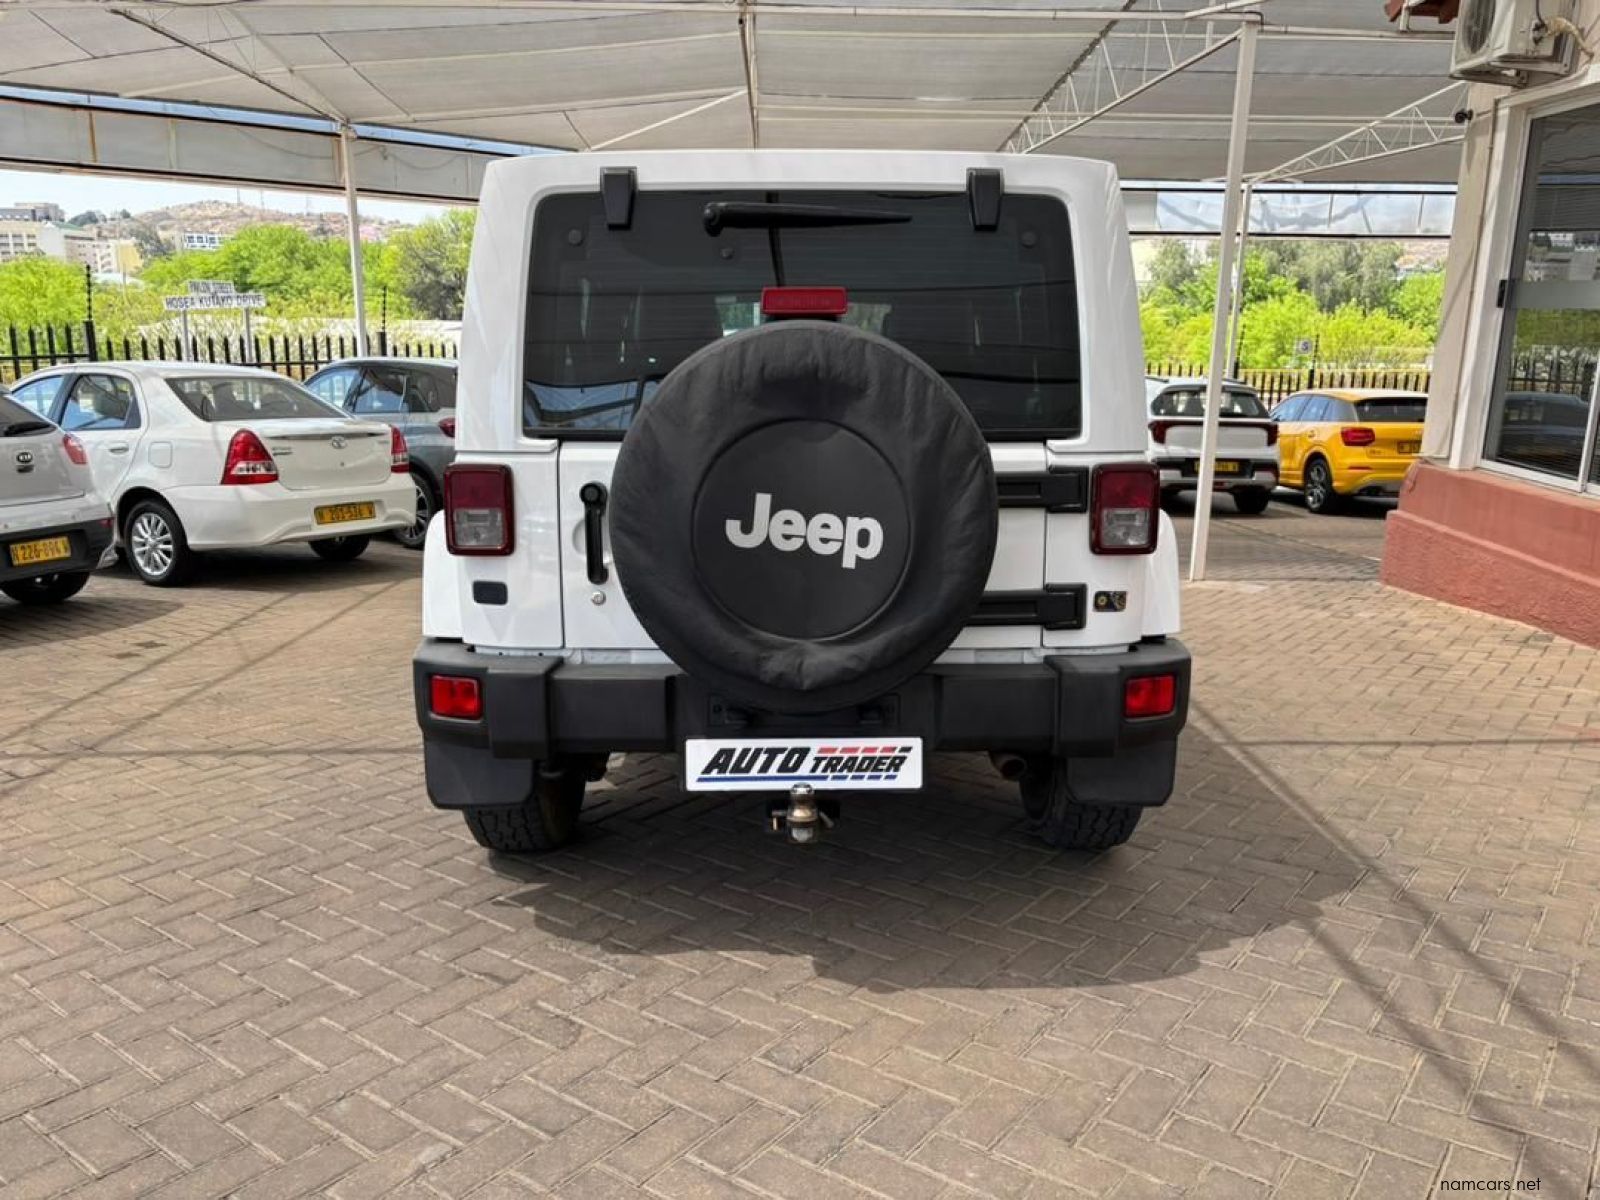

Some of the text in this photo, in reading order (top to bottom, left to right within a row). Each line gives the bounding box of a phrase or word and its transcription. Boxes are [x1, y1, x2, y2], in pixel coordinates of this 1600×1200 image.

[725, 492, 884, 570] Jeep
[701, 747, 908, 775] AUTO TRADER
